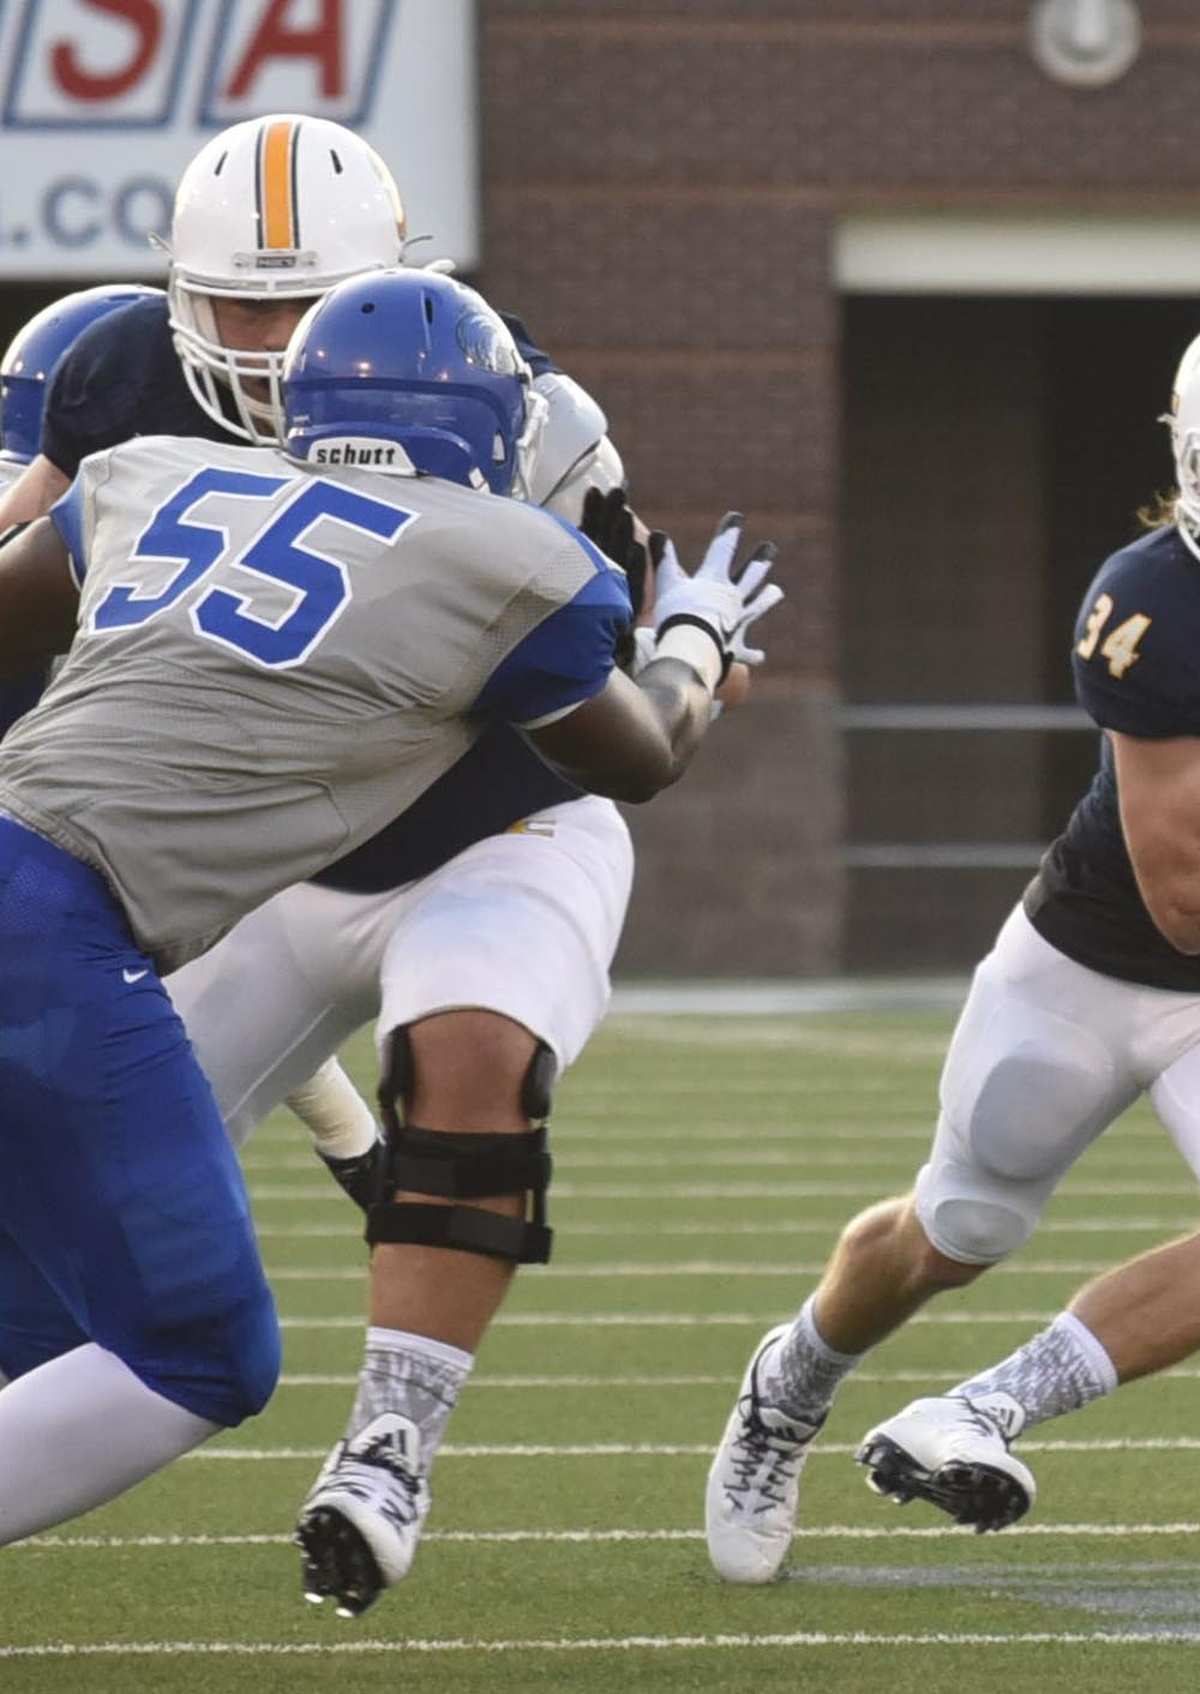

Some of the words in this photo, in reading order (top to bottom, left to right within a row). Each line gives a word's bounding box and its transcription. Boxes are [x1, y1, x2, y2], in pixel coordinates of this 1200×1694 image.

[316, 443, 397, 468] schutt
[87, 465, 421, 672] 55
[1075, 592, 1153, 680] 34
